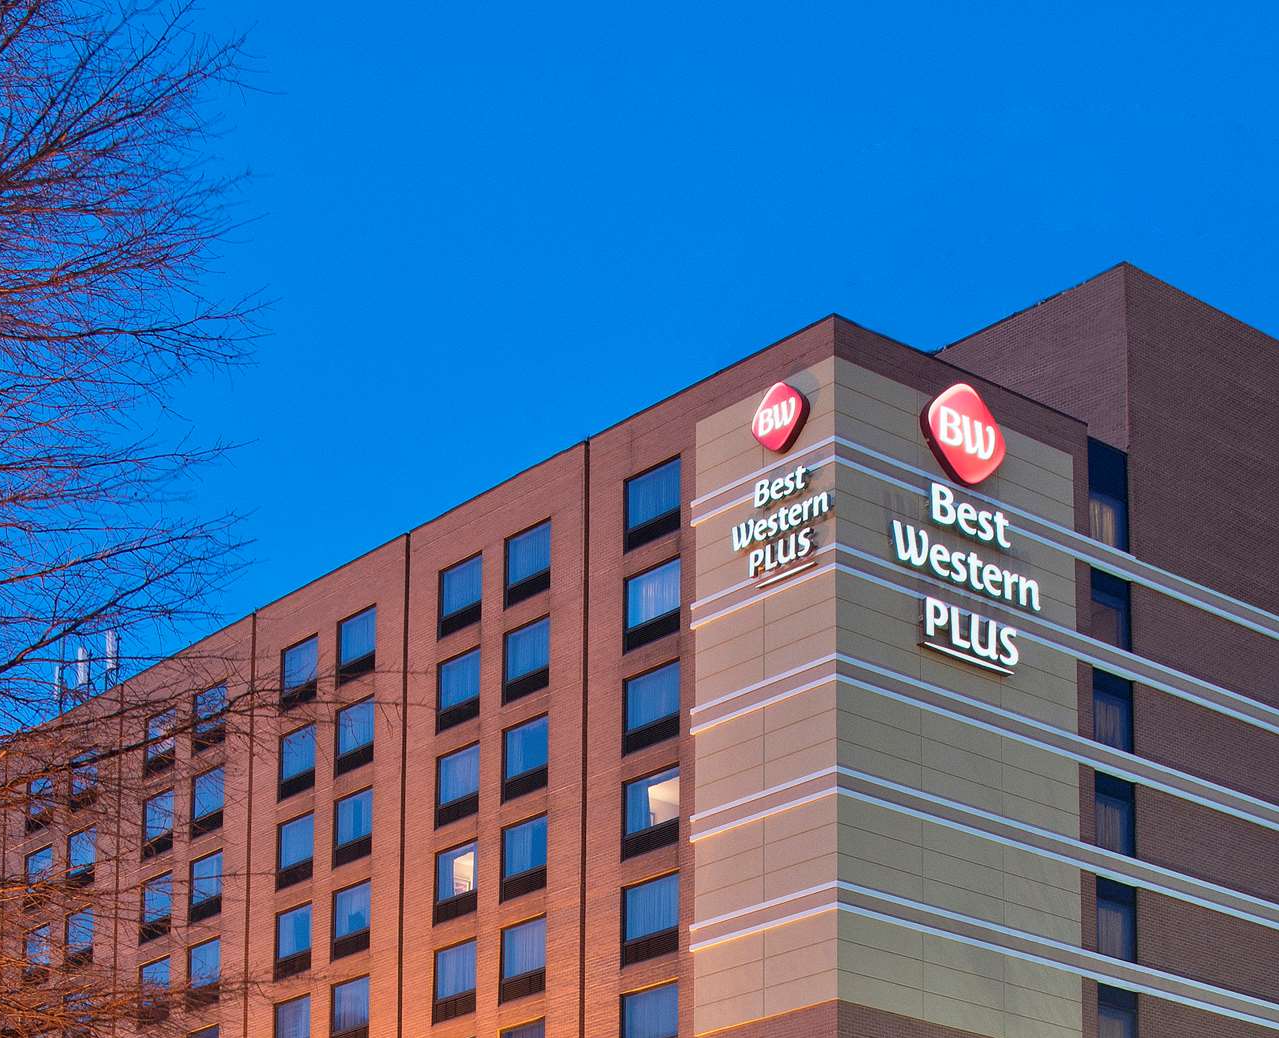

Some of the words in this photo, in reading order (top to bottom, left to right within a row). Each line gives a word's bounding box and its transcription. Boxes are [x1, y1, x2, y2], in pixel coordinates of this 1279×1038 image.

[758, 396, 796, 437] BW
[939, 406, 996, 460] BW
[754, 465, 807, 508] Best
[931, 482, 1011, 548] Best
[732, 491, 829, 551] Western
[749, 527, 812, 578] PLUS
[892, 519, 1042, 612] Western
[924, 596, 1020, 666] PLUS
